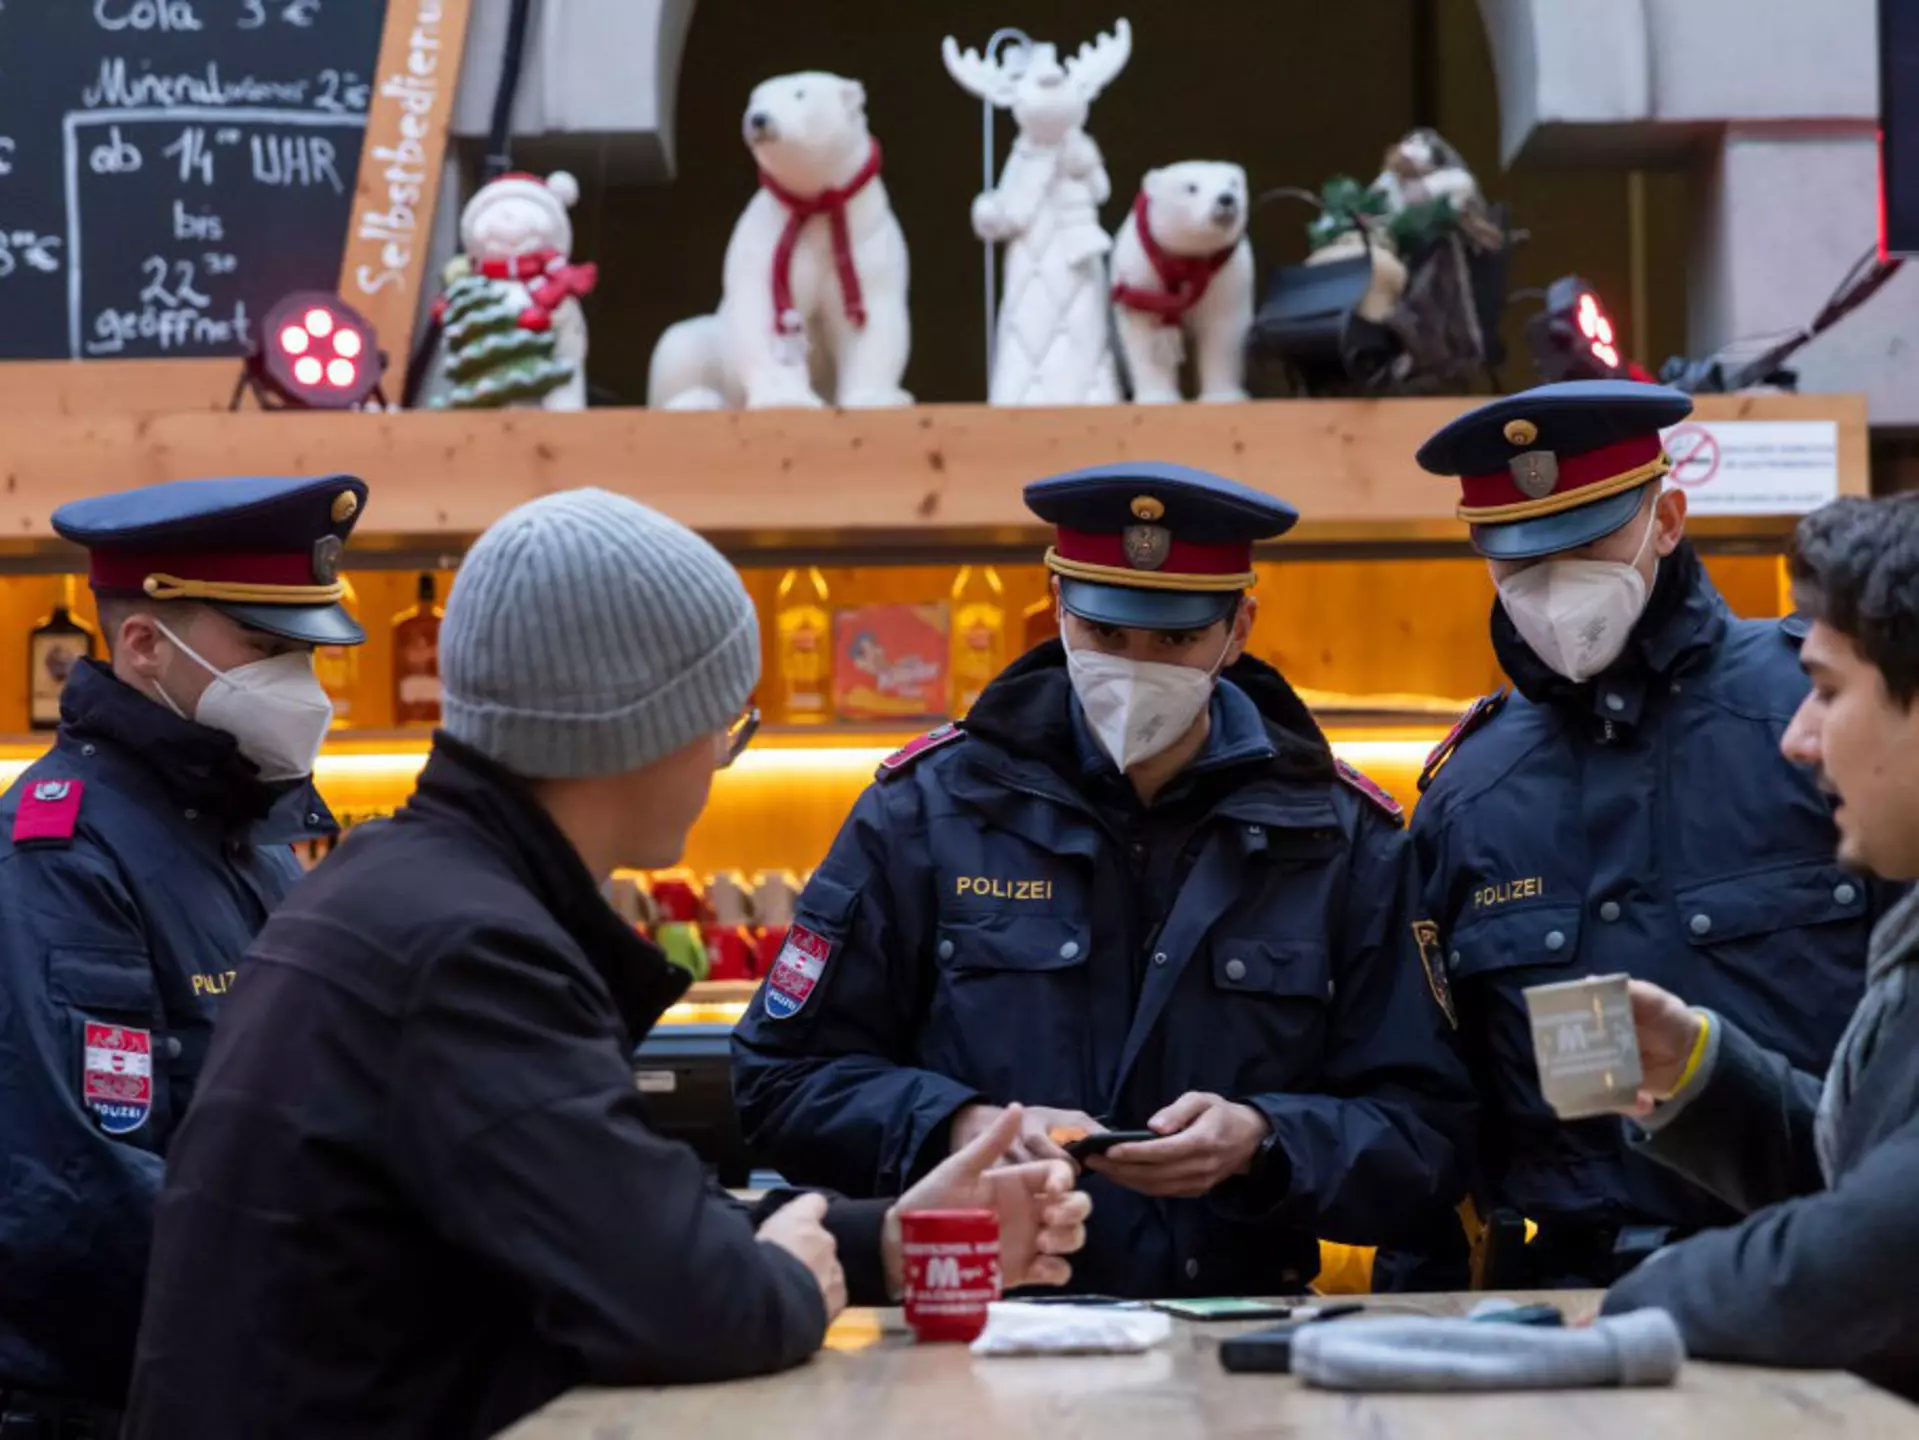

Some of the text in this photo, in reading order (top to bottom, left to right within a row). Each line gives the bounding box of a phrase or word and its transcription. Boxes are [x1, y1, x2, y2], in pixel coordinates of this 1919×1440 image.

[93, 0, 203, 31] Cola
[89, 125, 142, 174] ab
[250, 133, 344, 194] UHR
[173, 200, 224, 240] bis
[956, 876, 1052, 900] POLIZEI
[1474, 877, 1543, 909] POLIZEI
